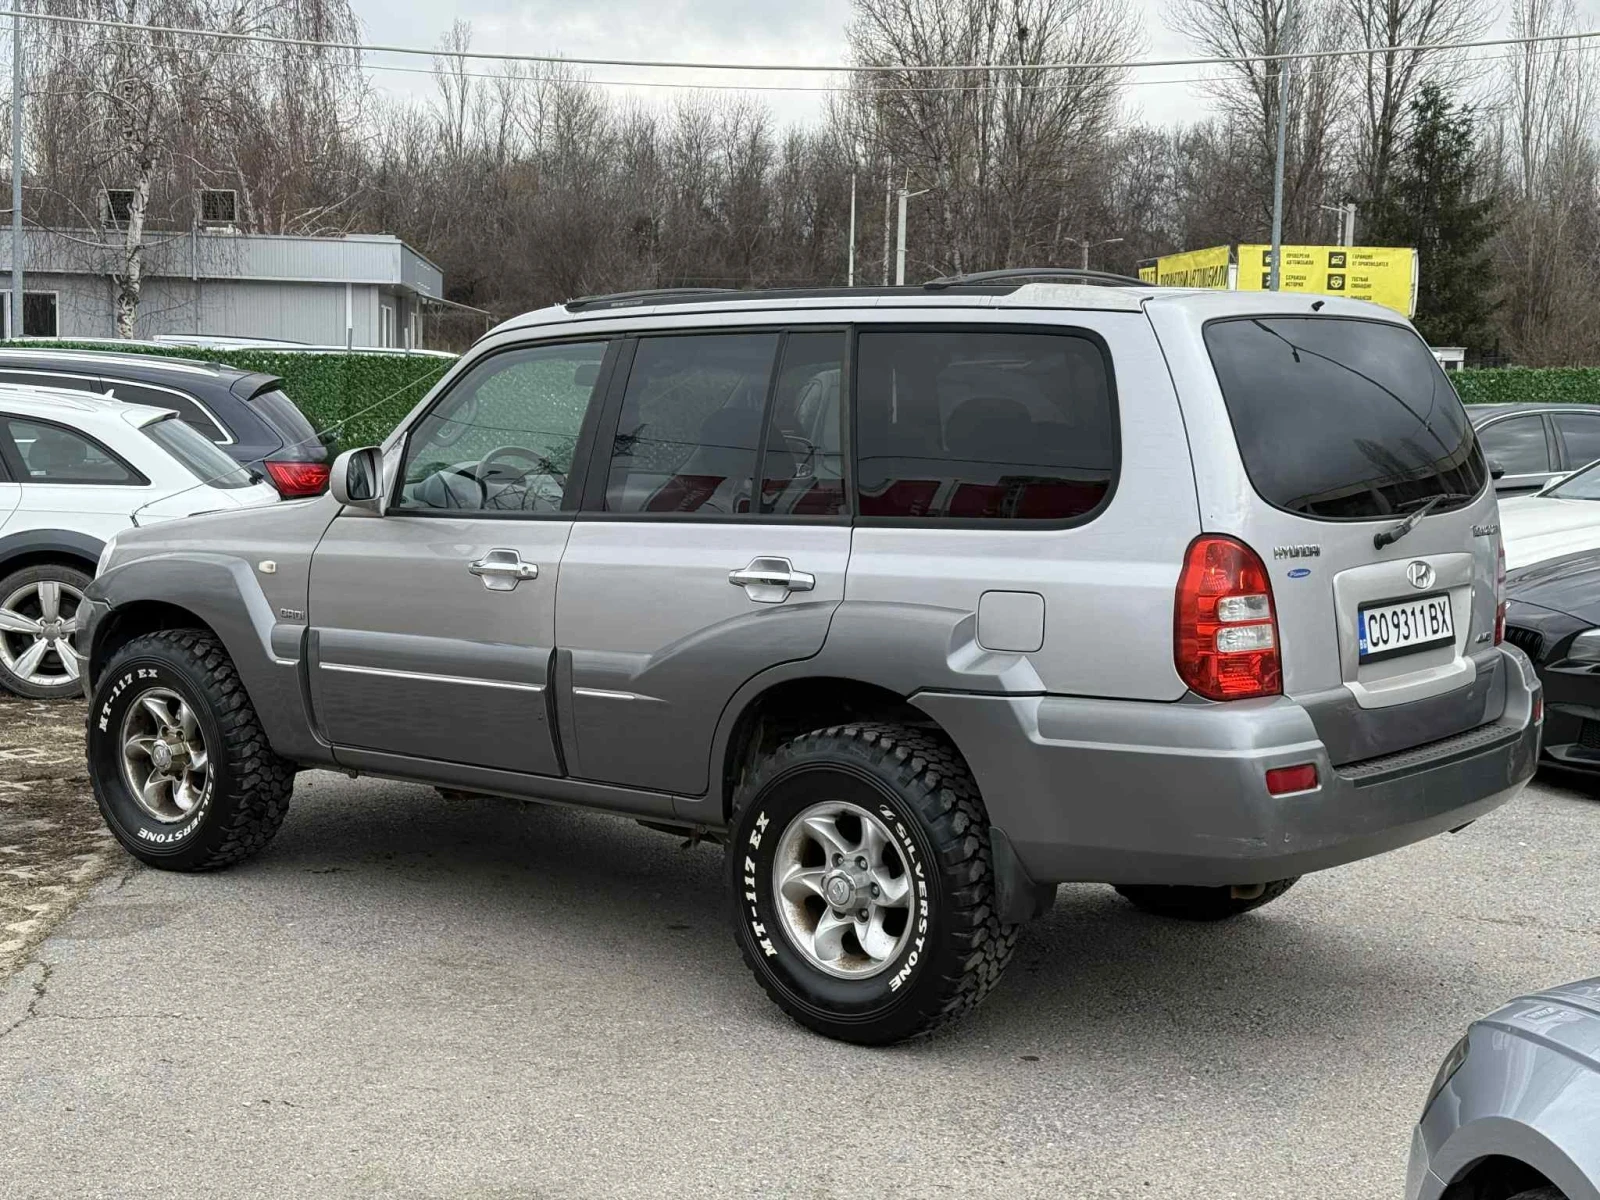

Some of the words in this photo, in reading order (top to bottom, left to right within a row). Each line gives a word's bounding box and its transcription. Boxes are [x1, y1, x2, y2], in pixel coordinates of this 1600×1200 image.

[1273, 544, 1321, 560] HYUNDAI
[137, 668, 158, 678] EX
[137, 782, 213, 843] SILVERSTONE
[749, 811, 770, 850] EX
[888, 822, 929, 992] SILVERSTONE
